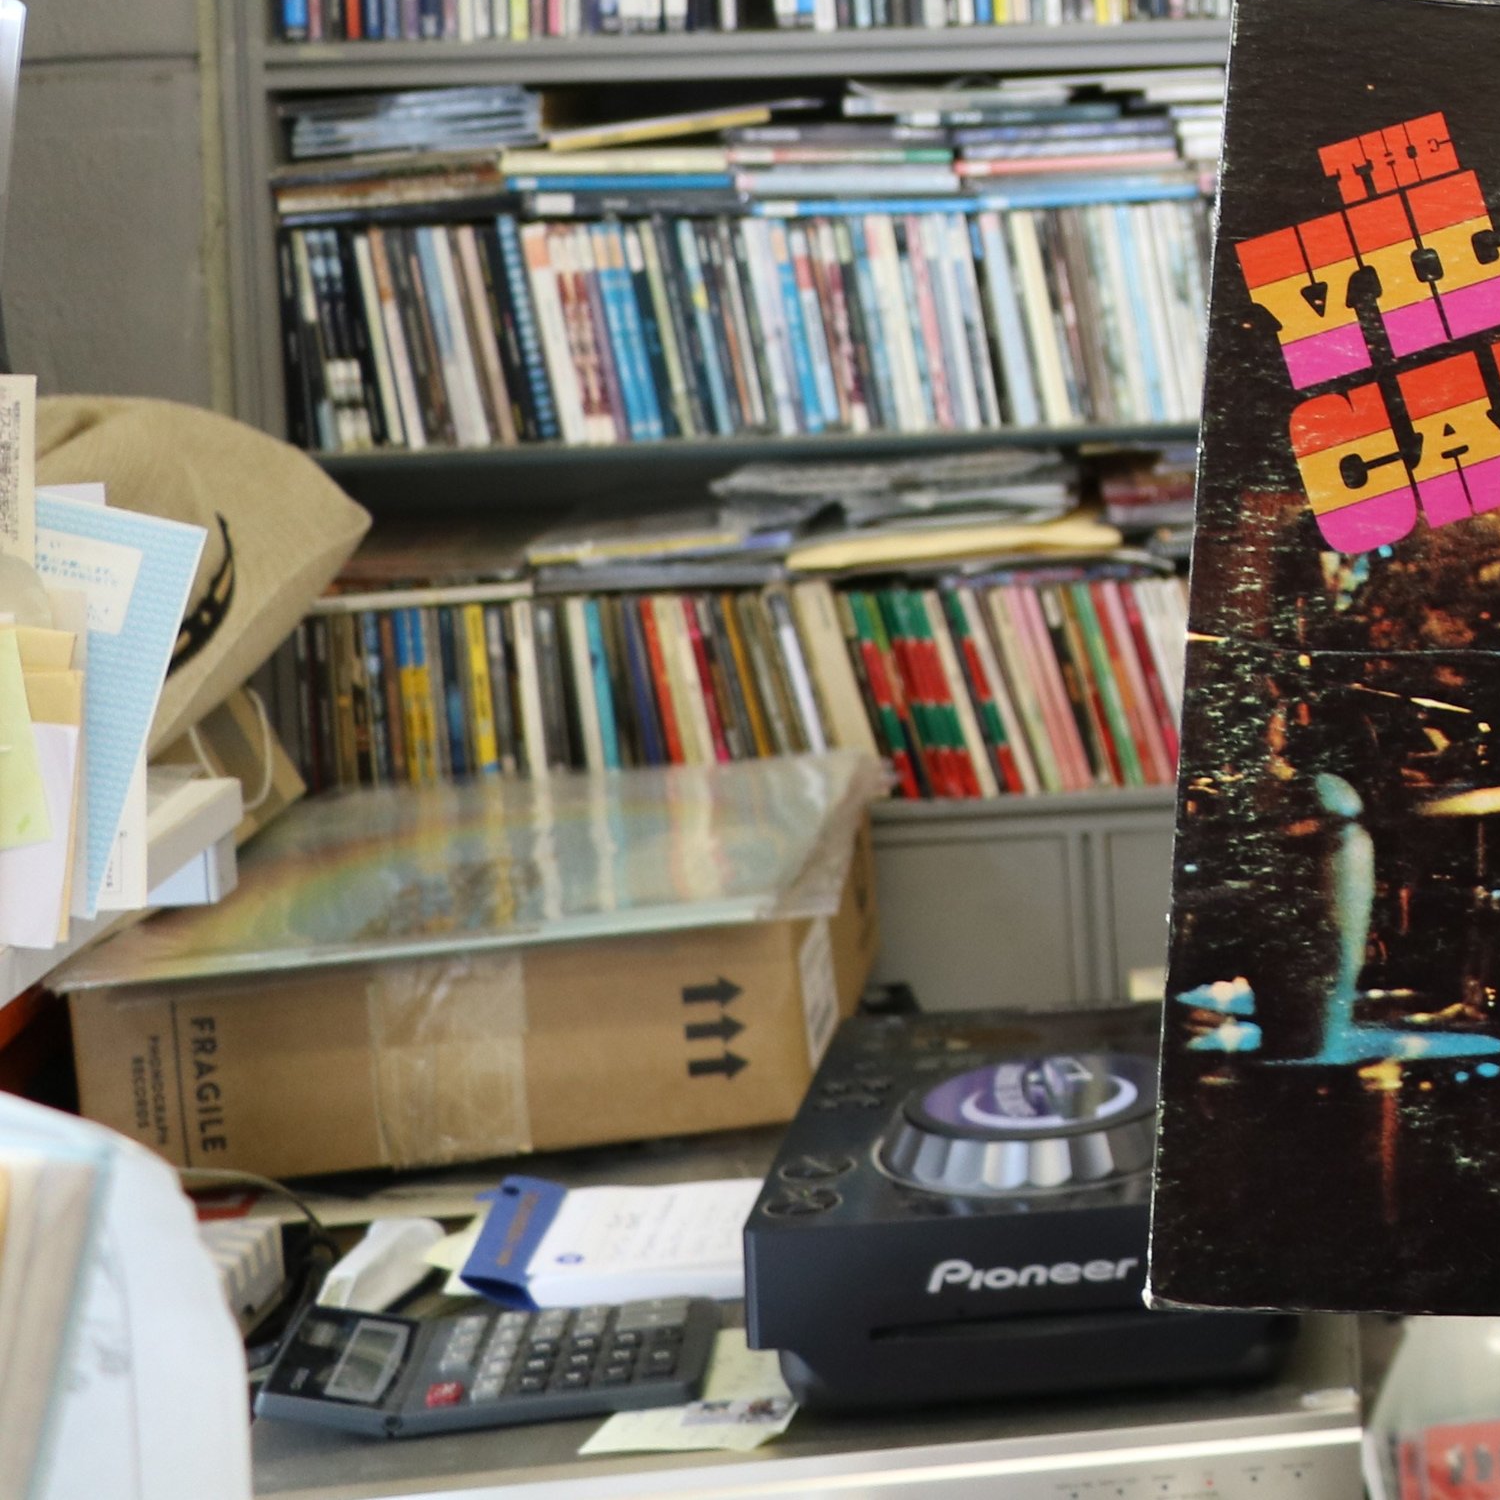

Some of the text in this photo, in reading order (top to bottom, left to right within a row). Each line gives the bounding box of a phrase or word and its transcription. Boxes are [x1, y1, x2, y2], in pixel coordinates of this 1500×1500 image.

[1317, 111, 1461, 206] THE
[190, 1016, 228, 1152] FRAGILE
[926, 1256, 1139, 1295] Pioneer
